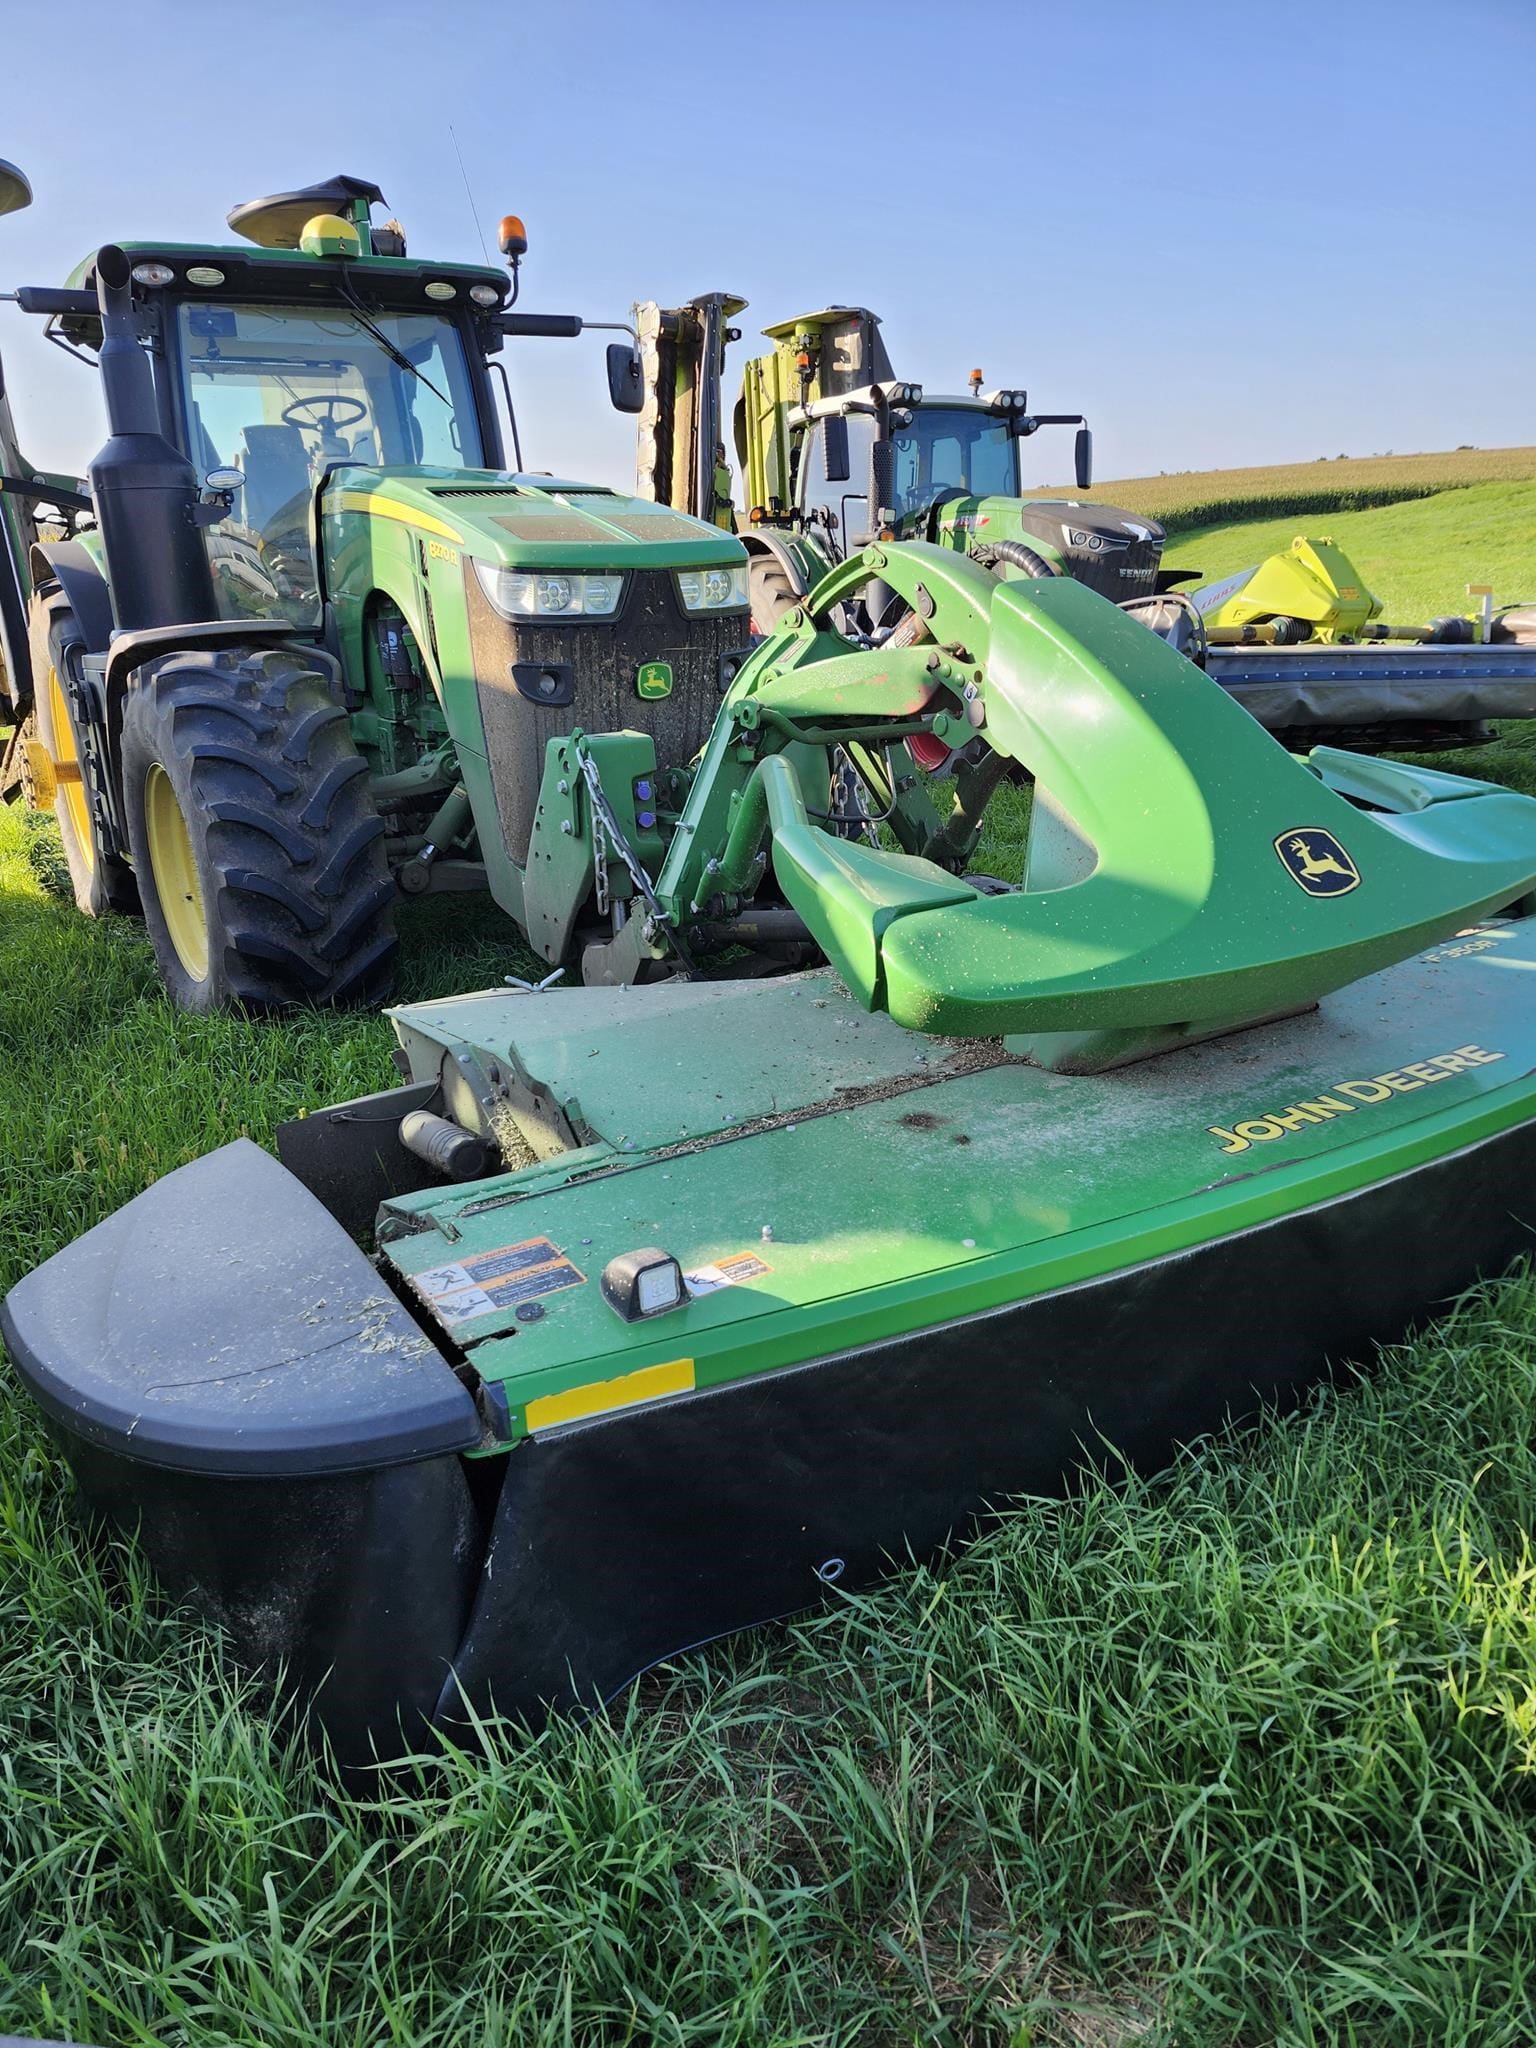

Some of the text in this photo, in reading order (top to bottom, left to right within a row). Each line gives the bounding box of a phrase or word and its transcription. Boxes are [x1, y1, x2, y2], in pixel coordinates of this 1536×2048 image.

[1119, 568, 1153, 578] FENDT
[1424, 940, 1498, 963] F 350R
[1206, 1043, 1507, 1155] JOHN DEERE
